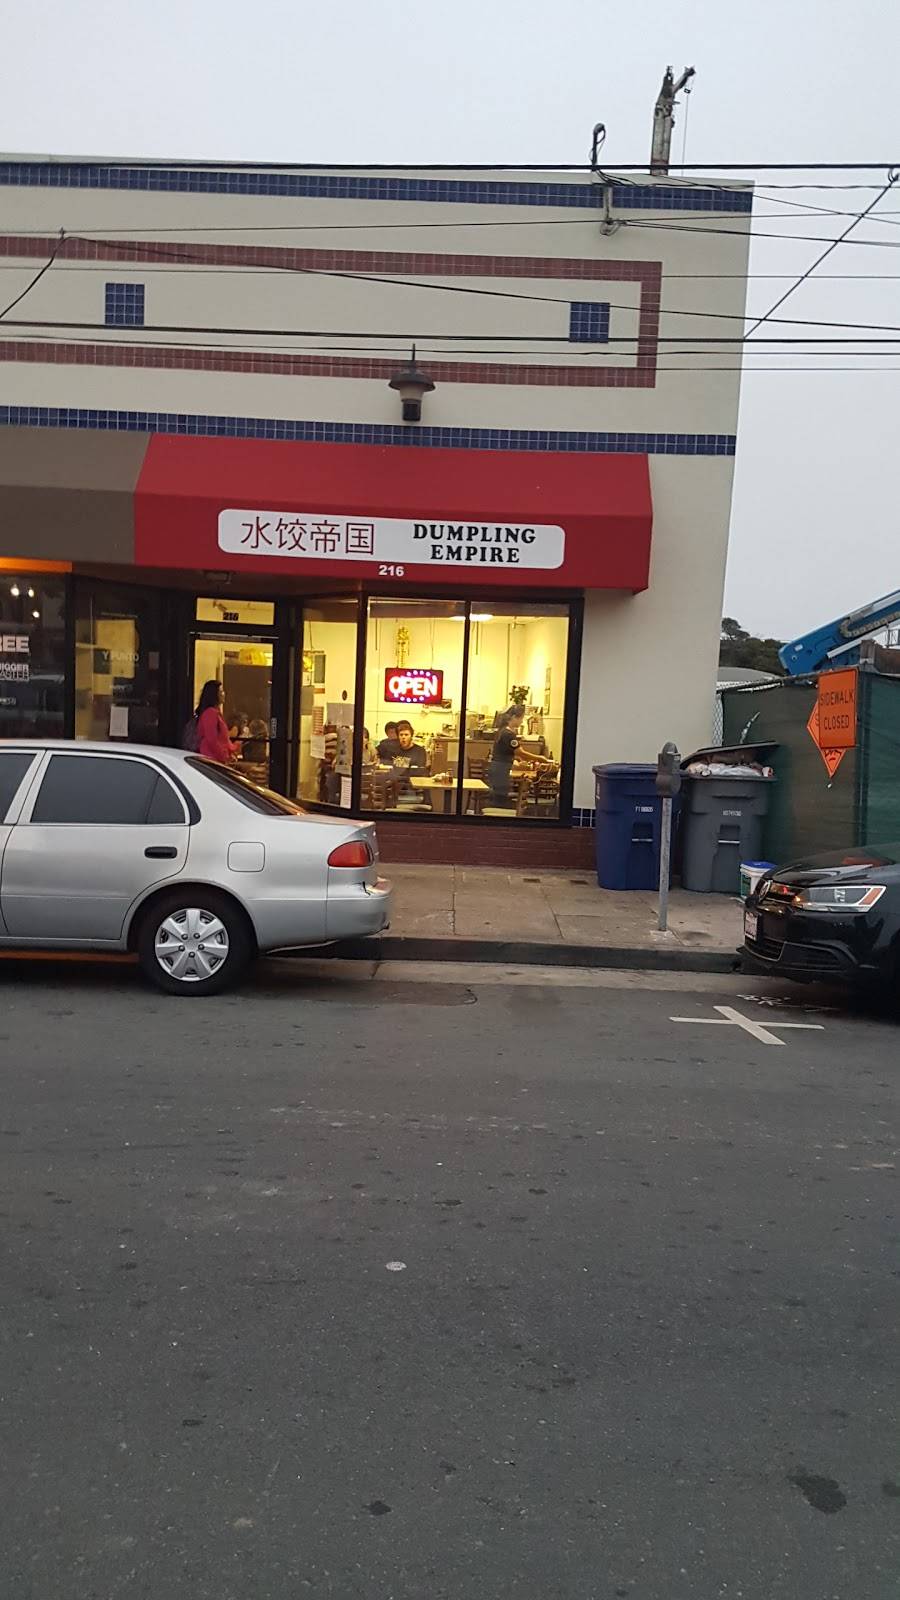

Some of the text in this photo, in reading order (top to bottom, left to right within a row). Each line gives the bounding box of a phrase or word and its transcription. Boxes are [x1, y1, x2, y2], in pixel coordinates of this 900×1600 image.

[240, 516, 375, 556] 水饺帝国
[413, 523, 536, 544] DUMPLING
[430, 544, 520, 563] EMPIRE
[378, 565, 405, 577] 216
[388, 675, 438, 697] OPEN
[820, 688, 855, 706] SIDEWALK
[823, 714, 850, 731] CLOSED
